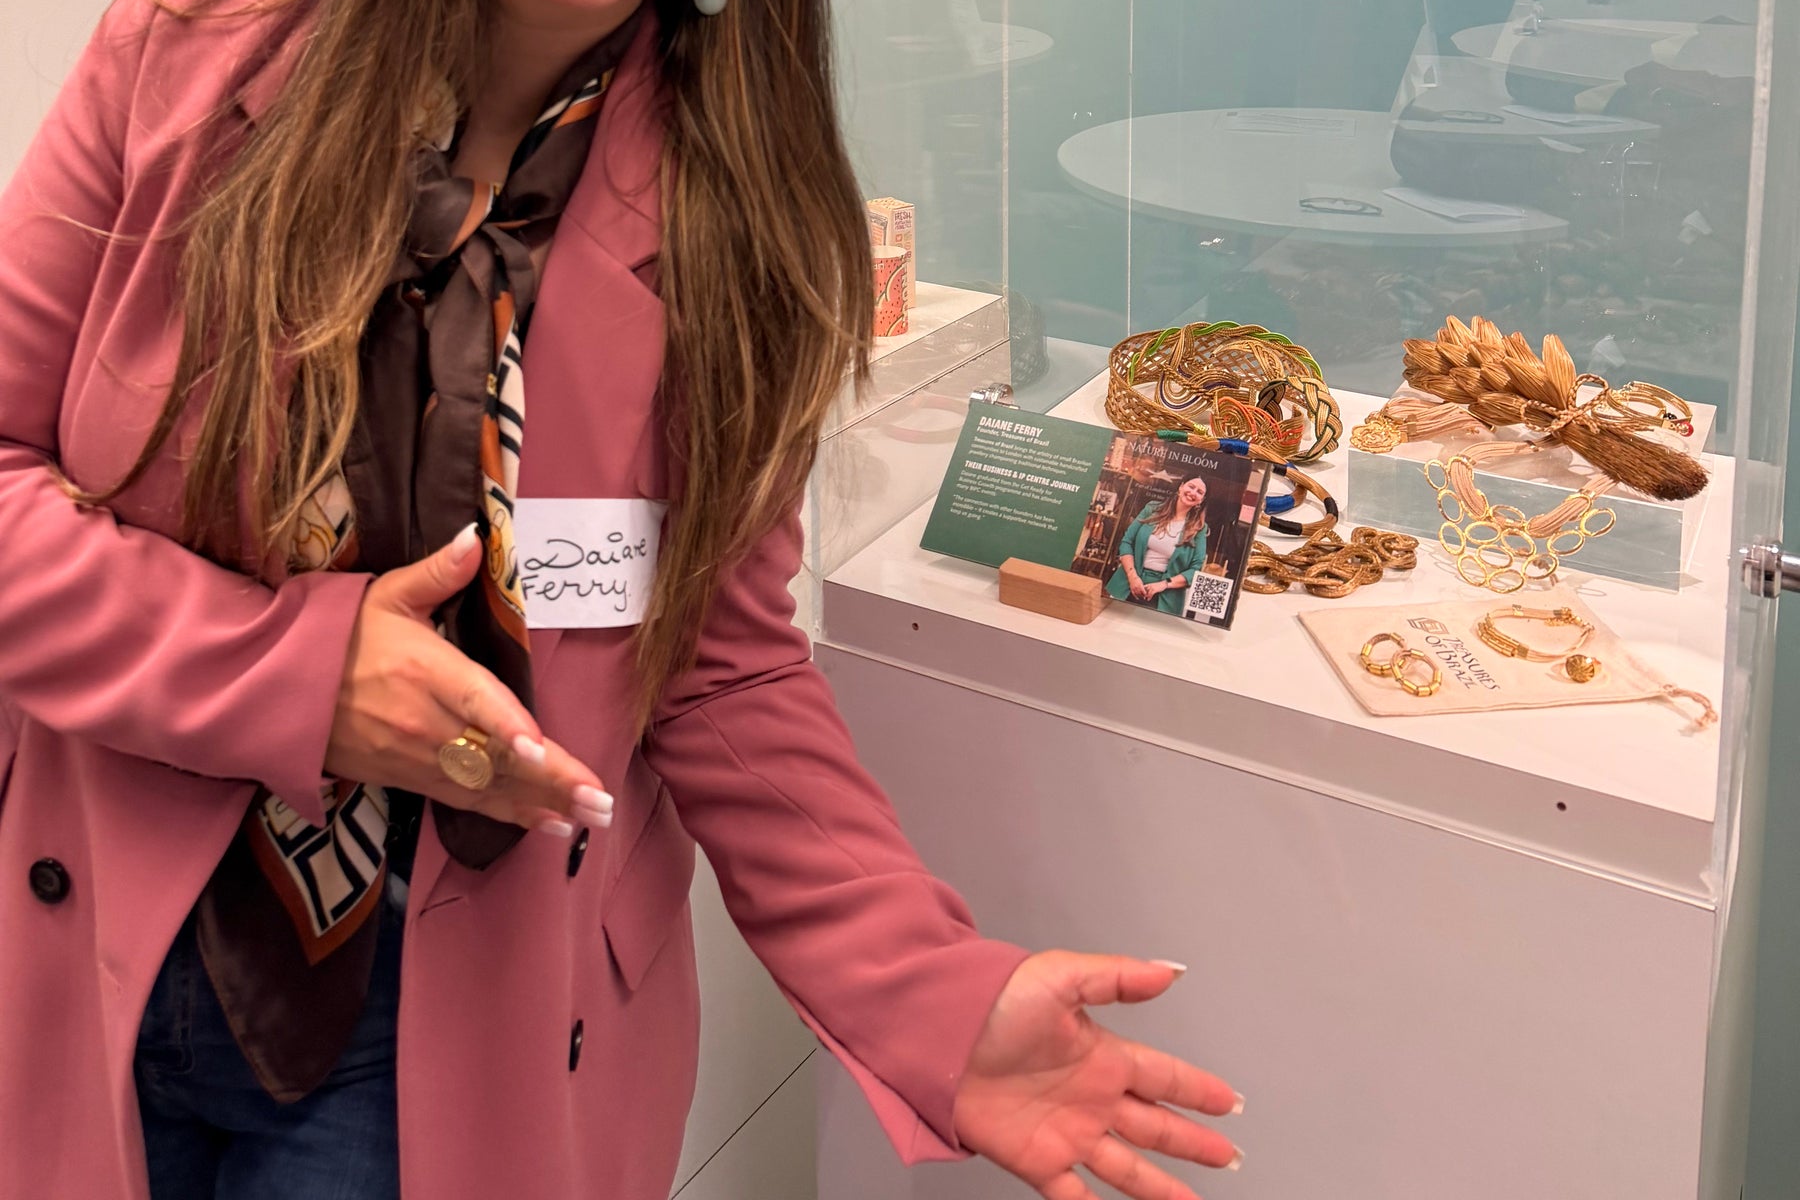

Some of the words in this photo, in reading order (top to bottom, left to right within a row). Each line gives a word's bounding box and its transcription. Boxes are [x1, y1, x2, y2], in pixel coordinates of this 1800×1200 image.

[976, 427, 1001, 437] Founder,
[1001, 432, 1026, 442] Treasures
[1034, 438, 1050, 447] Brazil
[979, 417, 1014, 432] DAIANE
[1014, 424, 1043, 438] FERRY
[1128, 441, 1168, 458] NATURE
[1168, 450, 1180, 461] IN
[1182, 455, 1218, 470] BLOOM
[964, 461, 982, 471] THEIR
[982, 465, 1012, 477] BUSINESS
[1012, 471, 1019, 479] &
[1026, 474, 1051, 486] CENTRE
[1051, 480, 1081, 492] JOURNEY
[524, 532, 648, 570] Daiane
[521, 574, 628, 613] Ferry
[1425, 635, 1448, 649] OF
[1442, 637, 1501, 690] TREASURES
